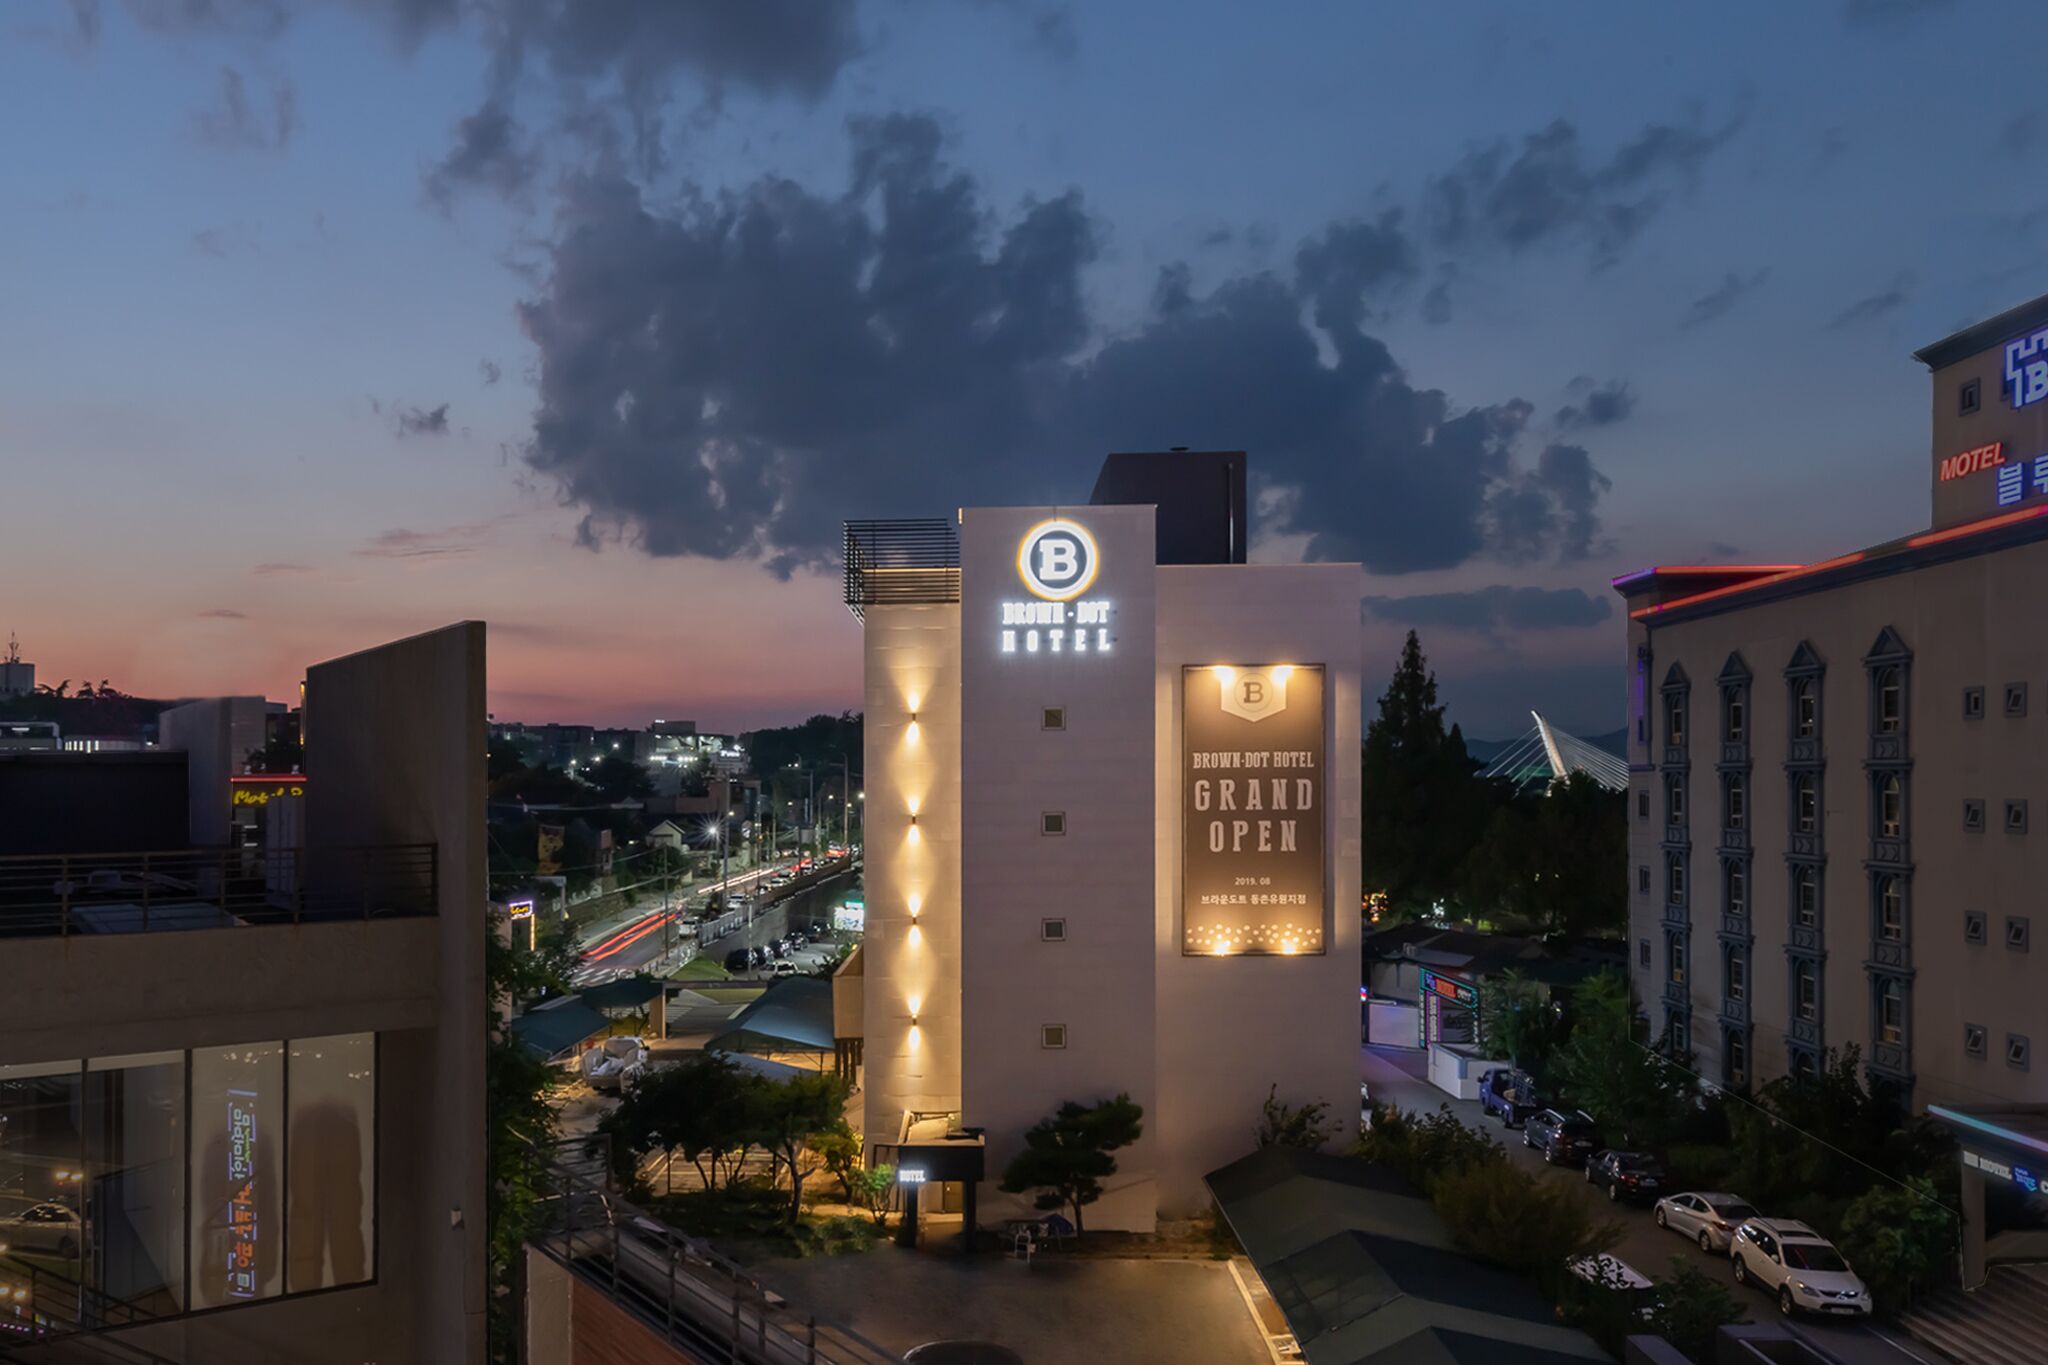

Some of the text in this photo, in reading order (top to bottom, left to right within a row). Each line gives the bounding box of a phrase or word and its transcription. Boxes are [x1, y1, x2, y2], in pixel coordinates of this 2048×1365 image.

[1940, 442, 2005, 481] MOTEL
[1039, 539, 1078, 580] B
[1002, 629, 1111, 652] HOTEL
[1243, 682, 1264, 703] B
[1273, 751, 1314, 768] HOTEL
[1194, 779, 1313, 811] GRAND
[1209, 820, 1297, 852] OPEN
[1201, 894, 1248, 905] 브라운도트
